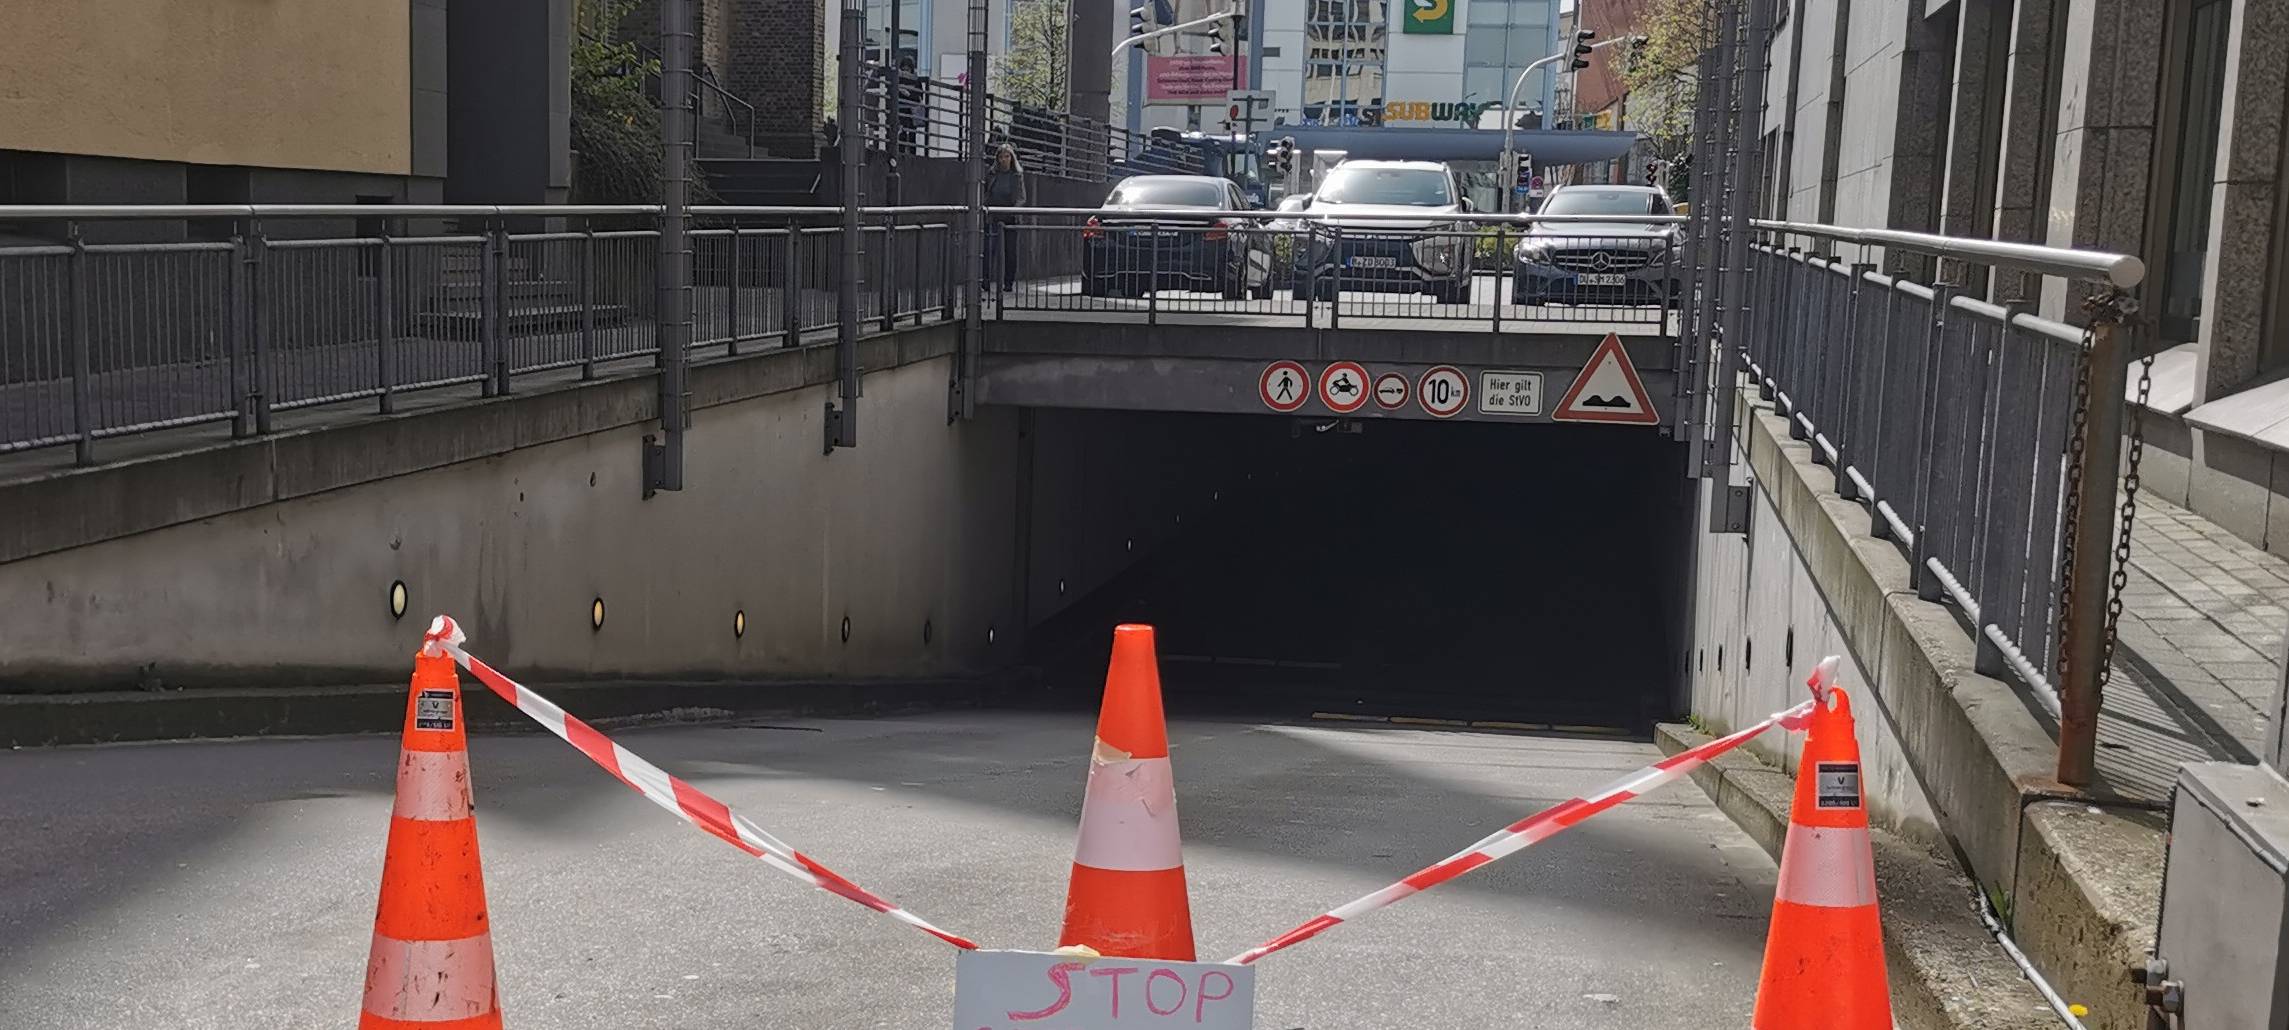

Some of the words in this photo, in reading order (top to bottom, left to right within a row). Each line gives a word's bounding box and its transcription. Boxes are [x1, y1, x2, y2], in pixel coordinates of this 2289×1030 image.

[1428, 378, 1450, 405] 10
[1489, 378, 1511, 391] Hier
[1514, 378, 1532, 394] gilt
[1489, 393, 1505, 406] die
[1508, 394, 1531, 407] StVO
[1007, 961, 1234, 1023] STOP
